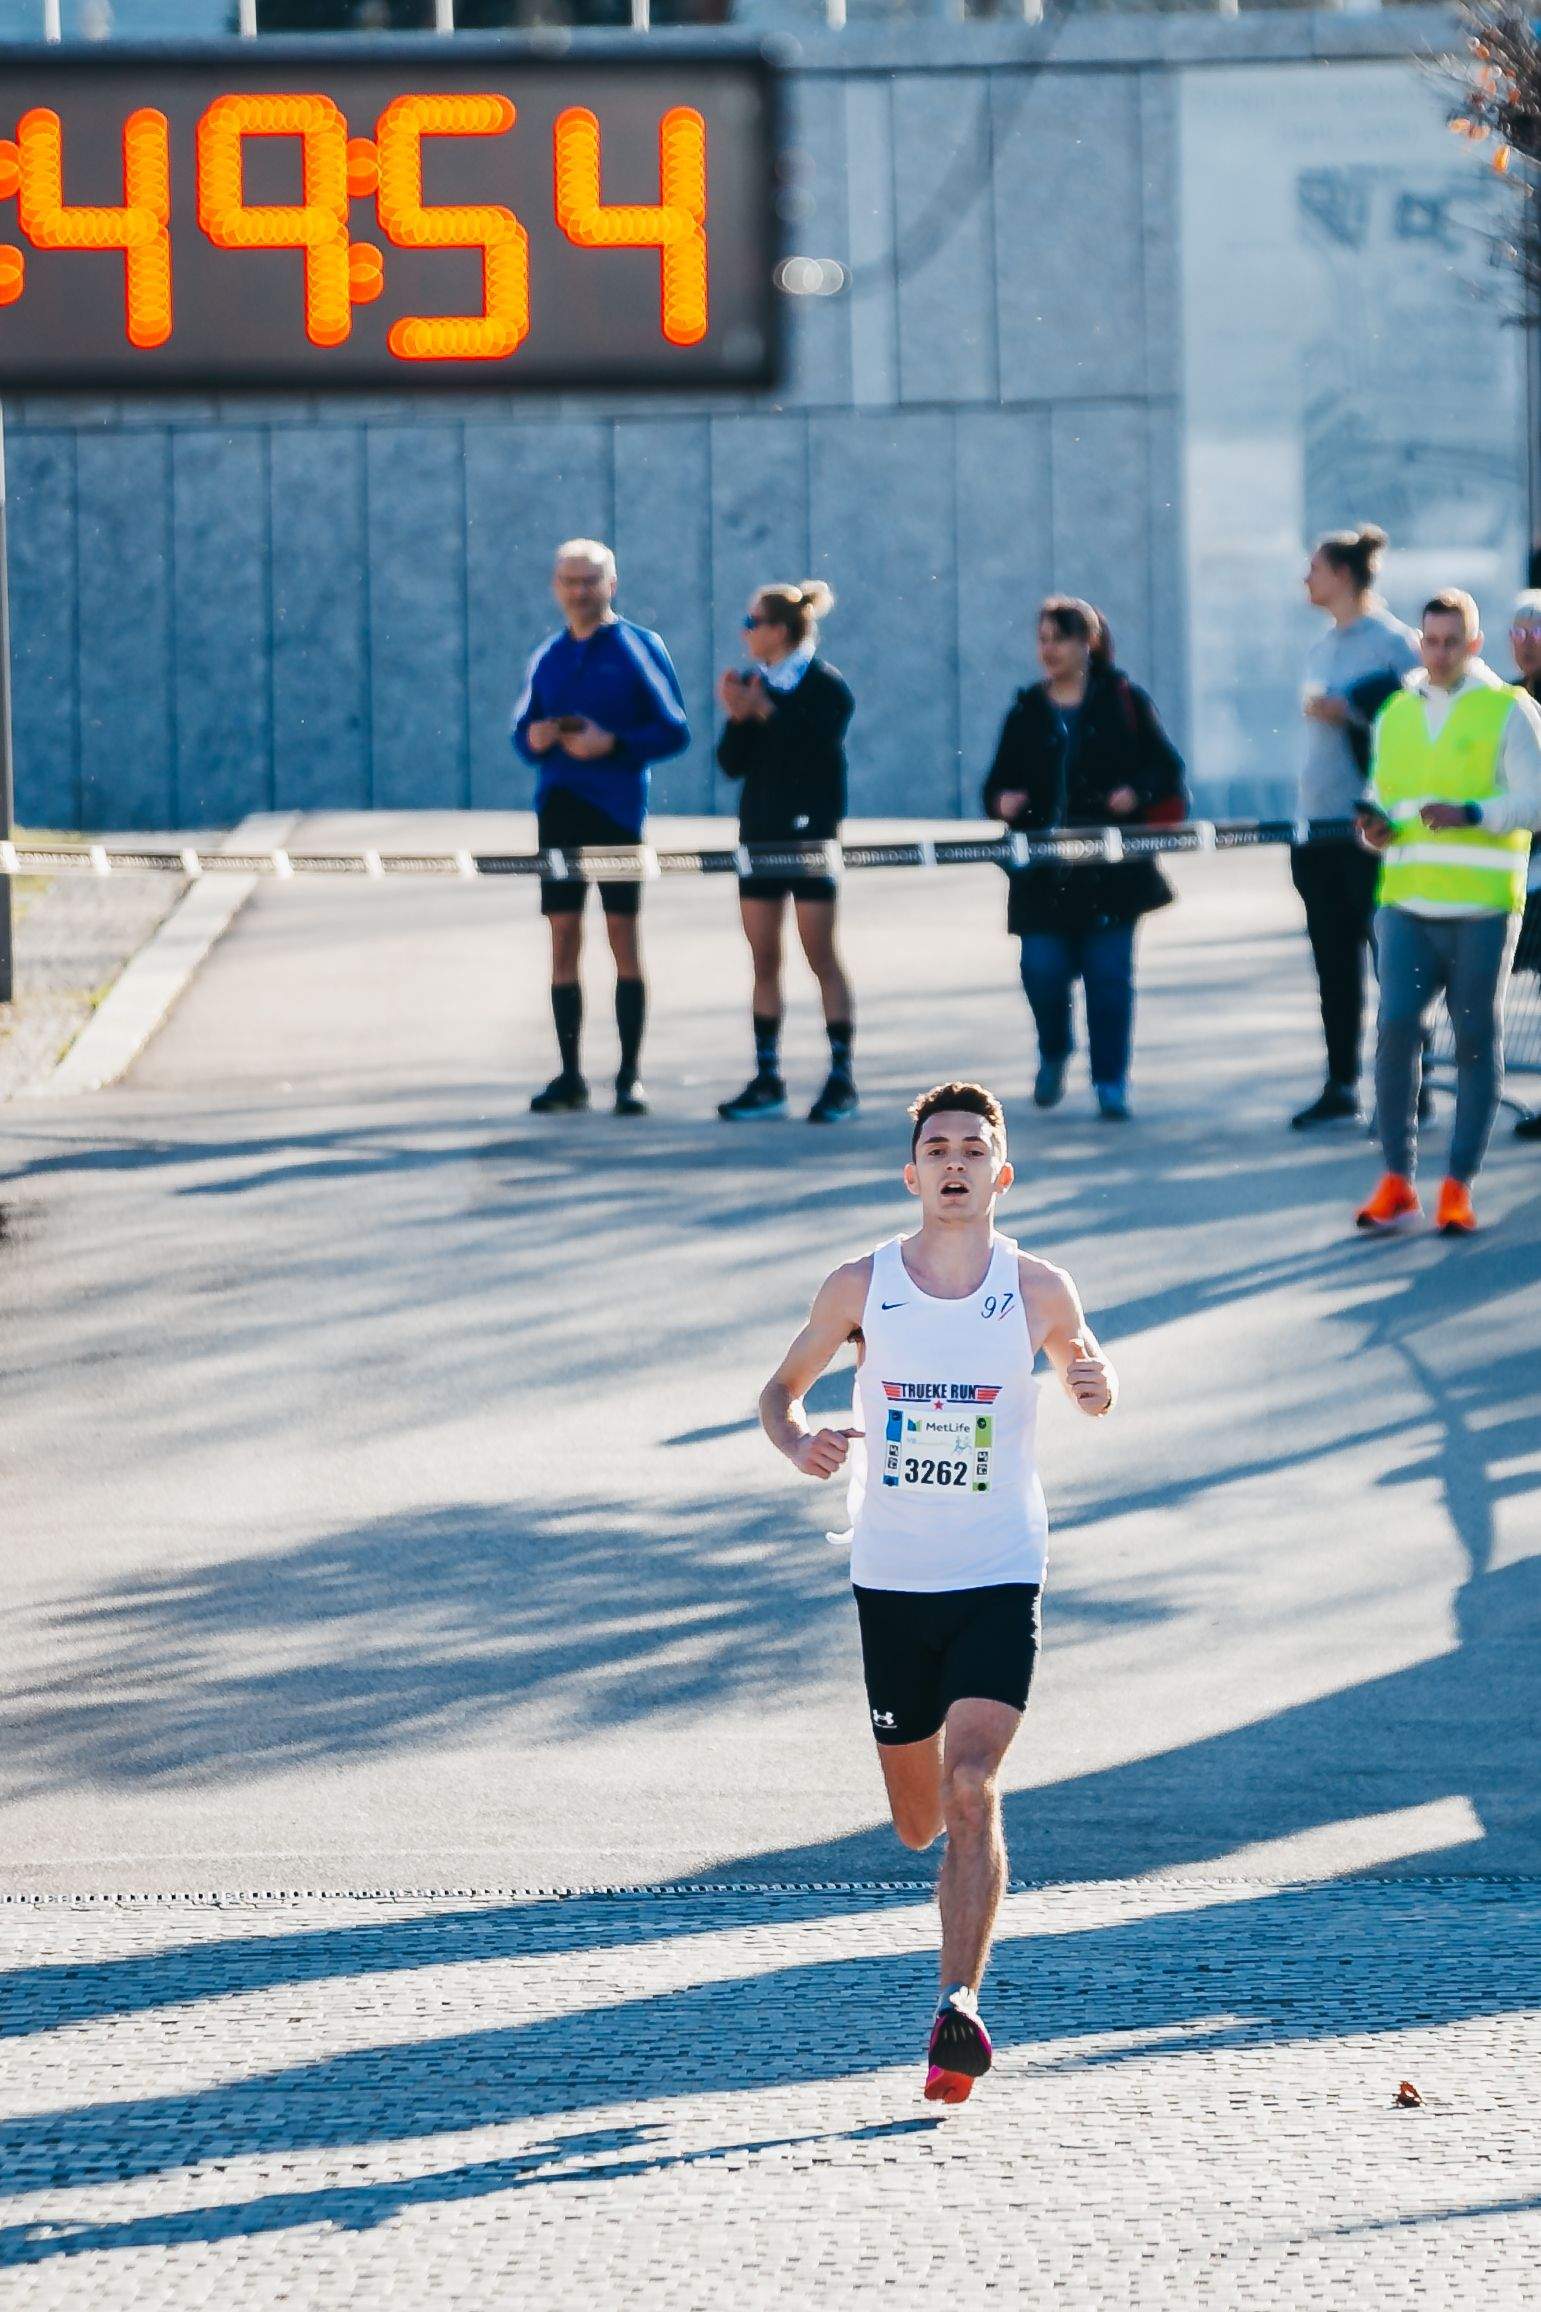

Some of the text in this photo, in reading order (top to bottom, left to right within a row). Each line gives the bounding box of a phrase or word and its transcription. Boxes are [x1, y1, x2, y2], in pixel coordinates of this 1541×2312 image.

[901, 1383, 977, 1400] TRUEKE RUN
[926, 1422, 971, 1433] MetLife
[904, 1458, 968, 1486] 3262
